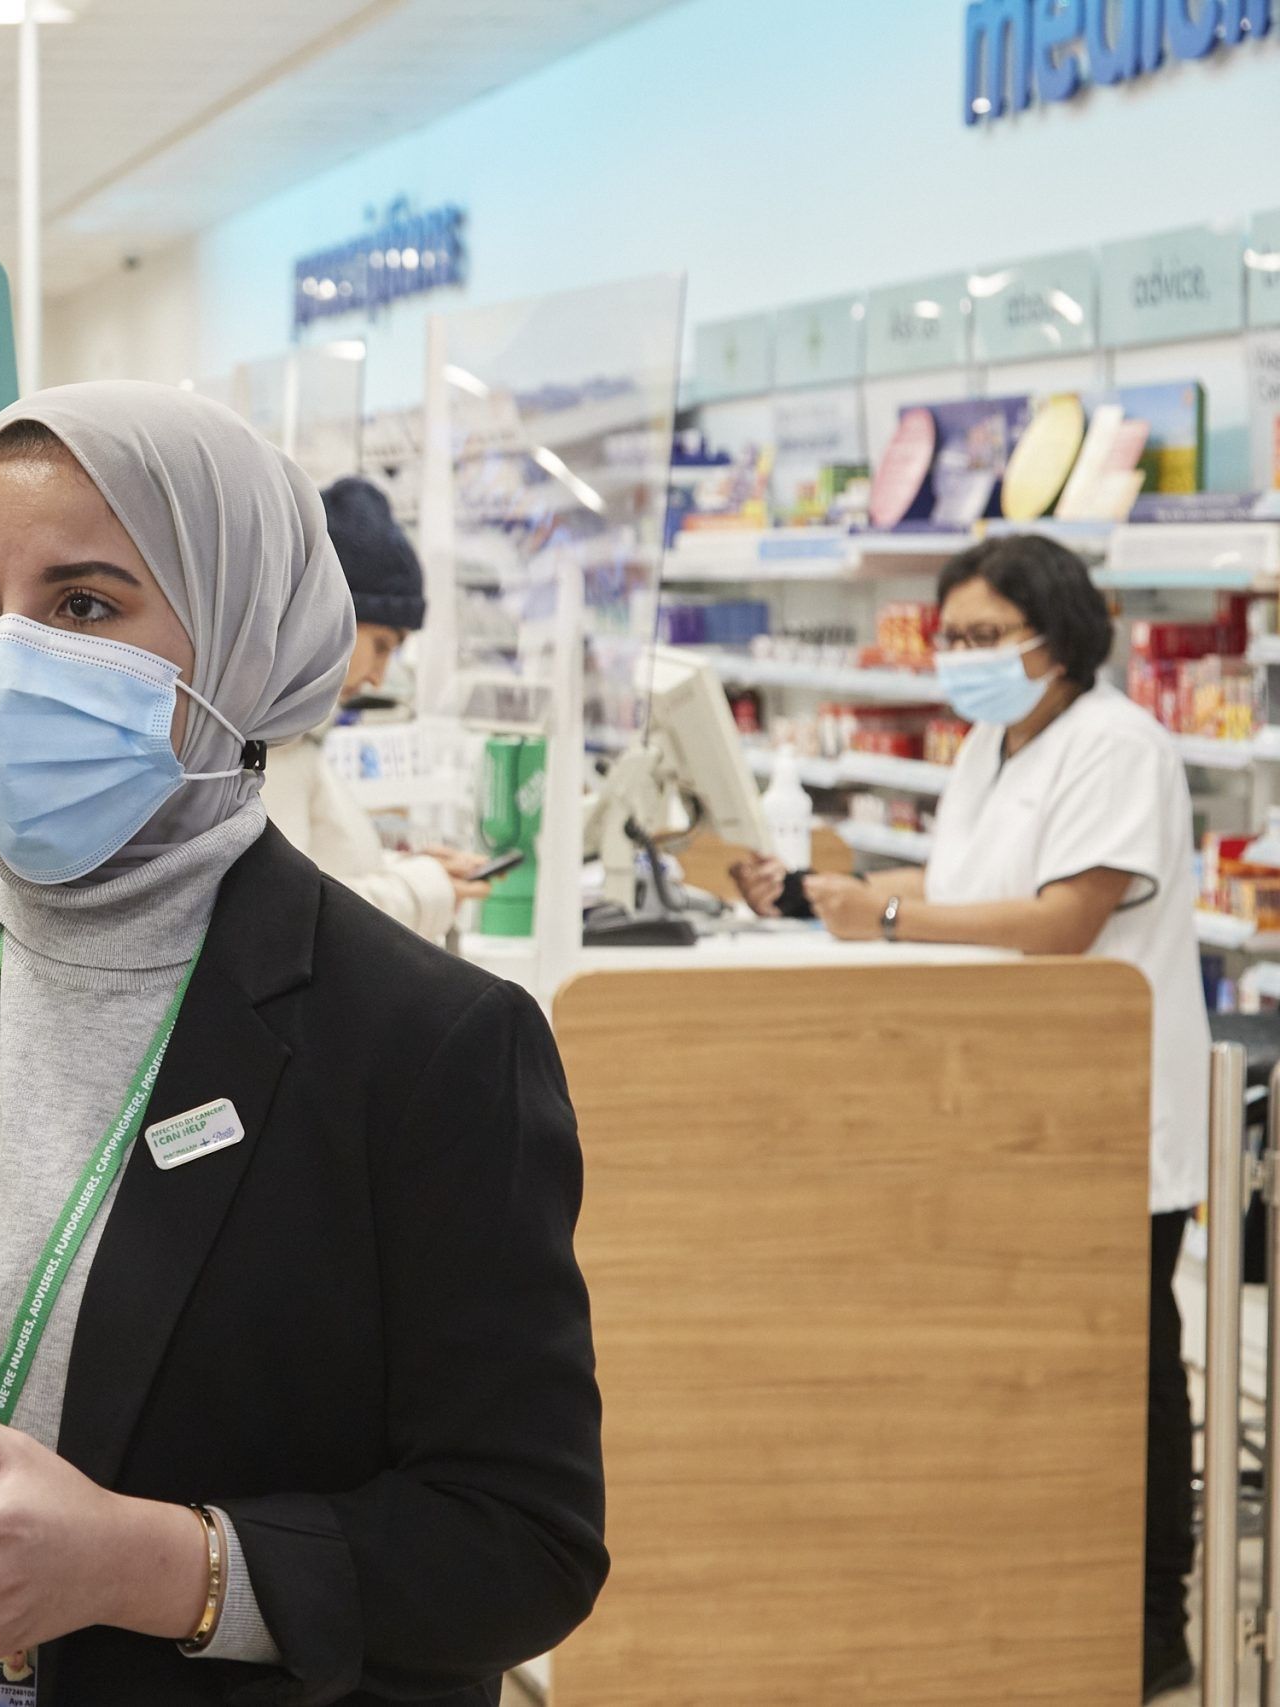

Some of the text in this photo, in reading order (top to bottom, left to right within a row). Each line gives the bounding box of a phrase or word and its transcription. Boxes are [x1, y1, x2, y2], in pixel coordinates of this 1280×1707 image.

[159, 1132, 181, 1145] CAN
[182, 1120, 207, 1137] HELP
[10, 1319, 37, 1370] NURSES,
[30, 1257, 61, 1318] ADVISERS,
[55, 1175, 102, 1256] FUNDRAISERS,
[95, 1091, 148, 1172] CAMPAIGNERS,
